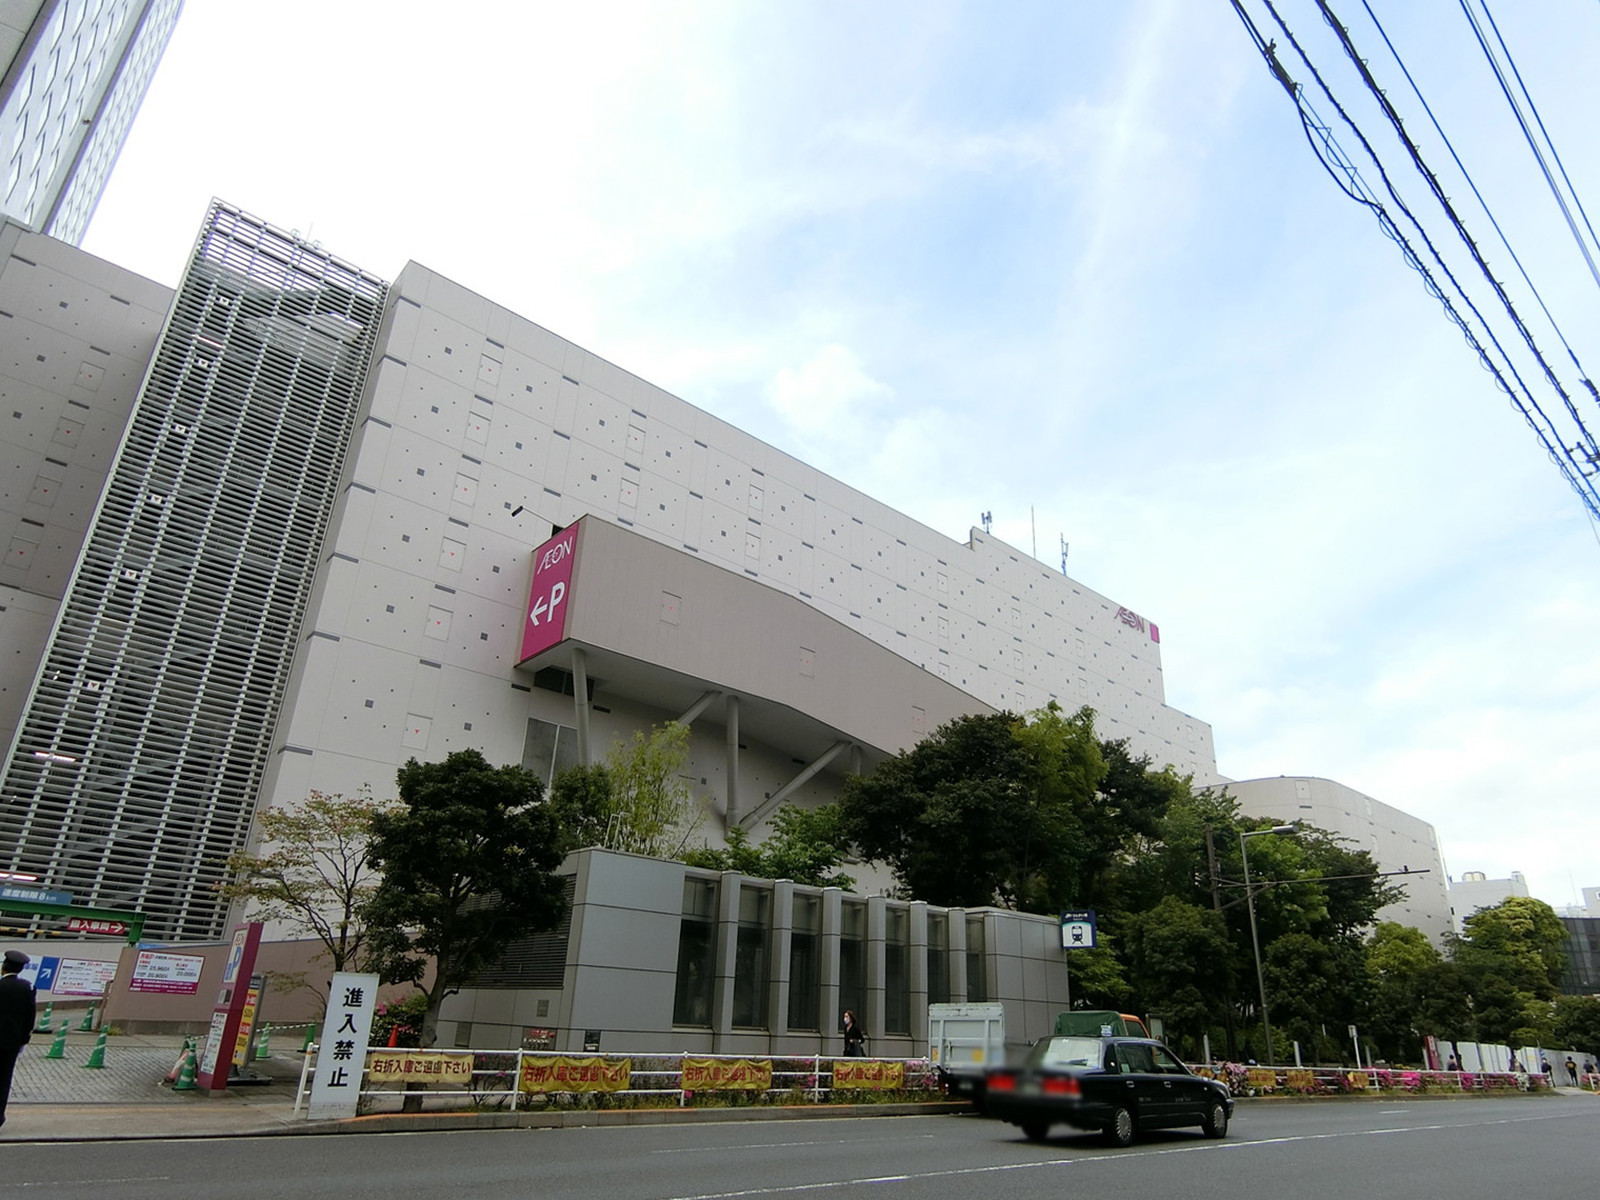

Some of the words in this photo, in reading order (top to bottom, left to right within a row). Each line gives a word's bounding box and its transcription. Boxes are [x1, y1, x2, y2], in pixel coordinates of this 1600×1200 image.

[547, 581, 565, 623] P
[327, 987, 364, 1087] 進入禁止
[372, 1059, 471, 1075] 右折入庫ご遠慮下さい
[523, 1065, 629, 1083] 右折入庫ご遠慮下さい
